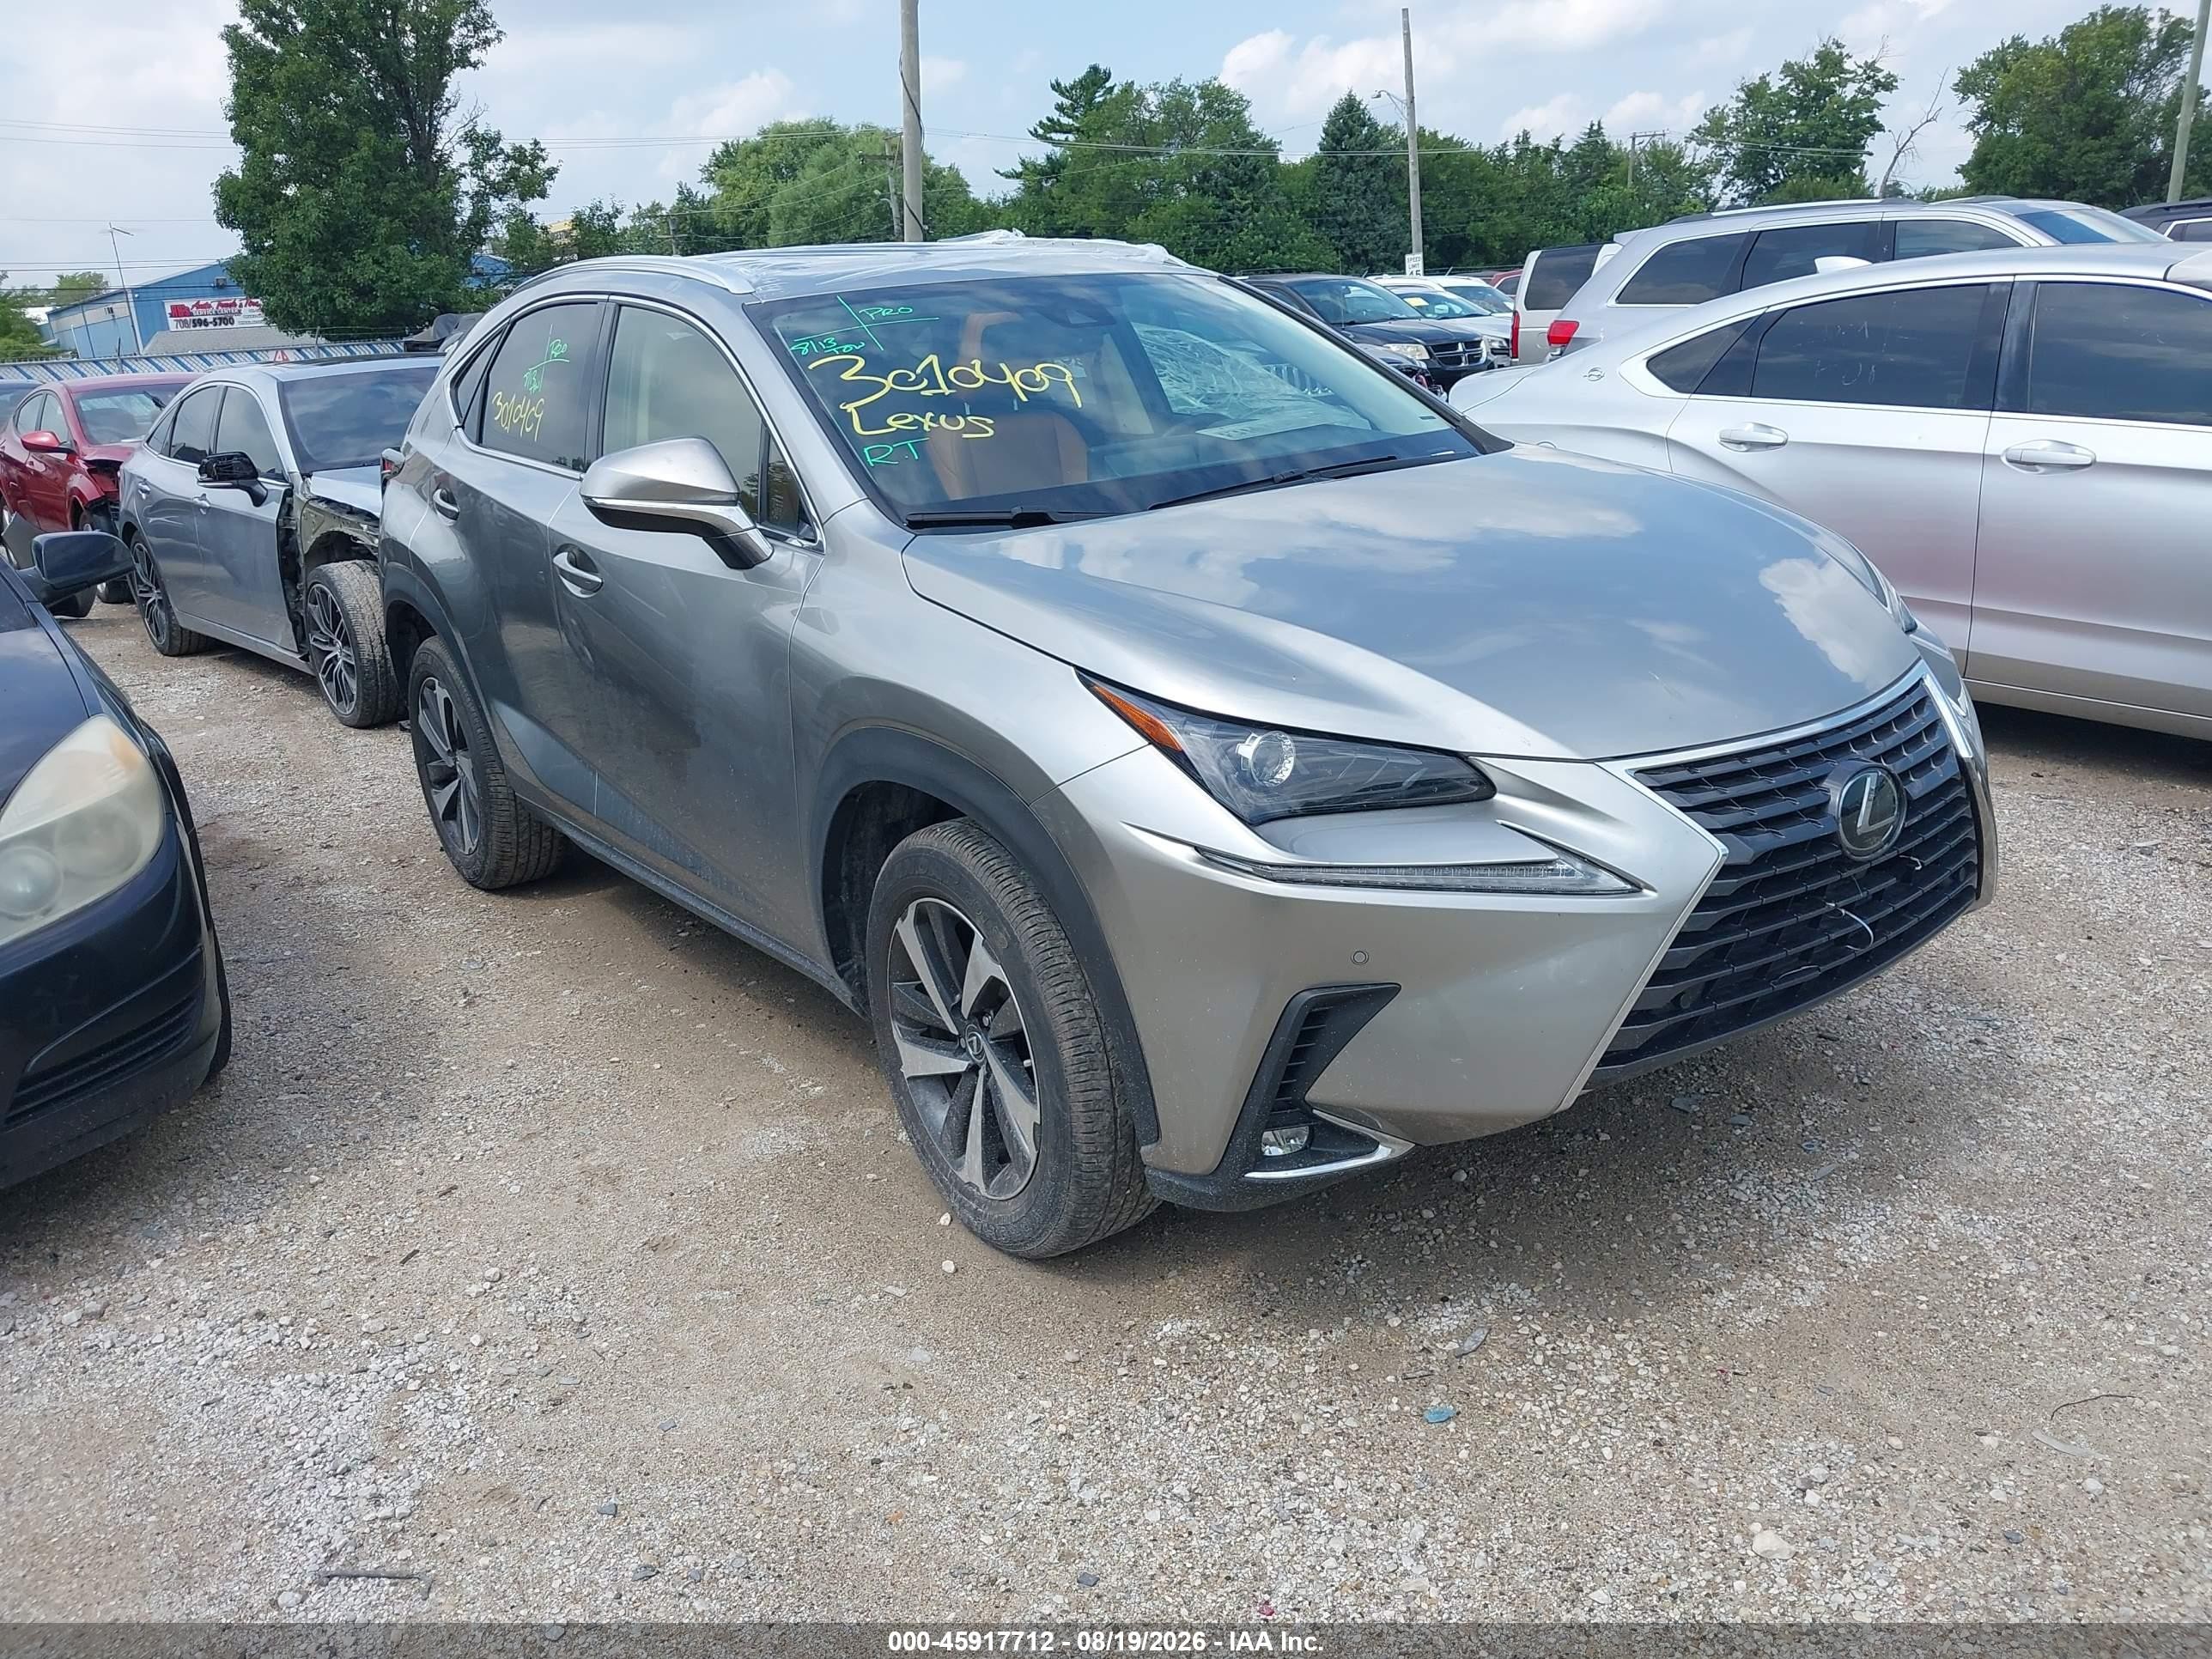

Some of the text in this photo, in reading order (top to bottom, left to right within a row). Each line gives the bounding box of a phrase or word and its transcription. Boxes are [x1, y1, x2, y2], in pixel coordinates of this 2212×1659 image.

[173, 317, 234, 329] 708/596-5700
[808, 354, 1083, 410] 3010409
[845, 407, 995, 439] Lexus
